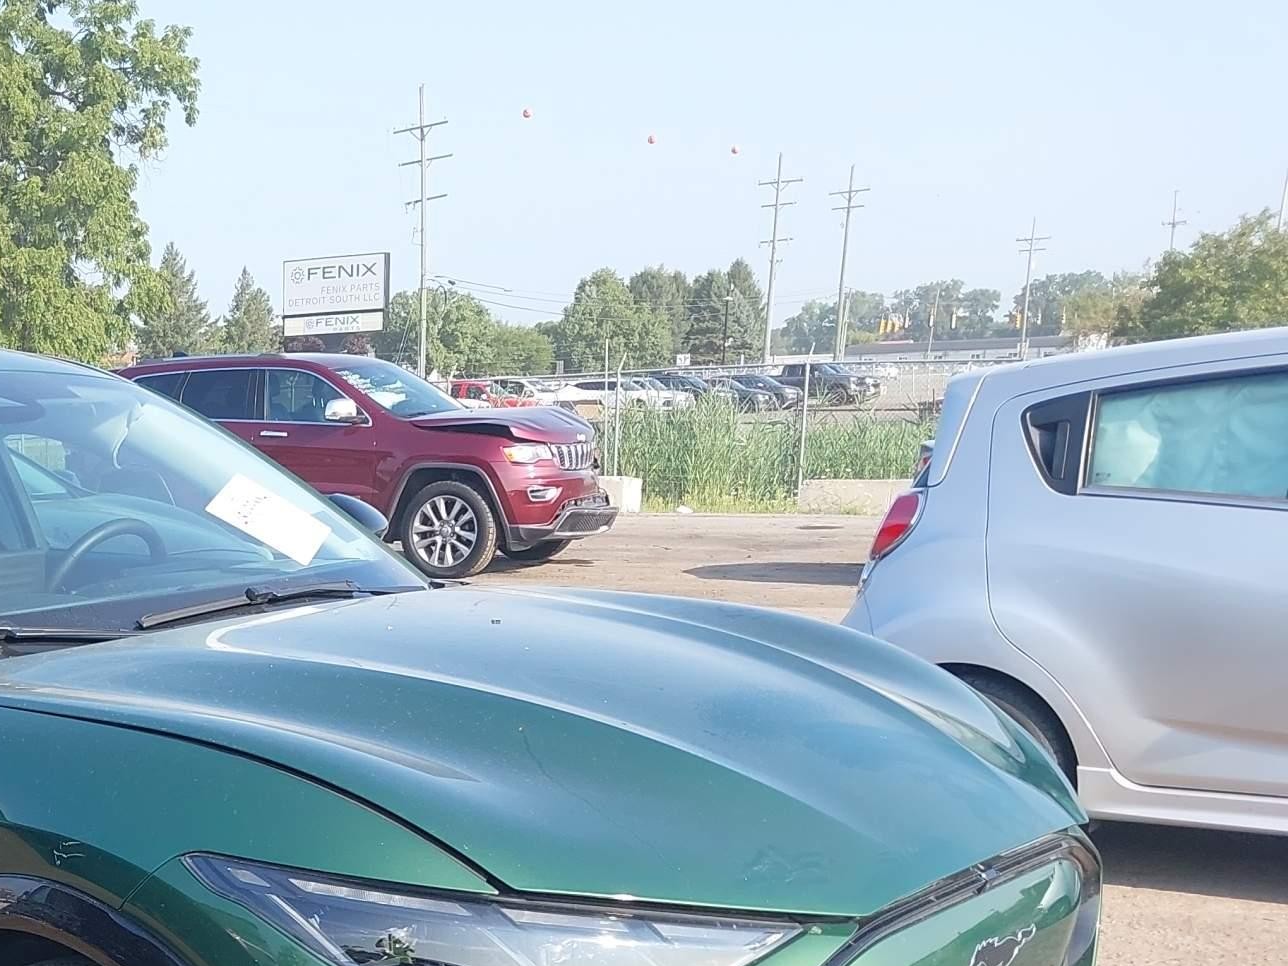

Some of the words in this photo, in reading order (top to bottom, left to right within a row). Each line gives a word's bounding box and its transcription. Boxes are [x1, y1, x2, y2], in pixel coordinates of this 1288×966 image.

[307, 262, 377, 280] FENIX
[320, 285, 348, 295] FENIX
[350, 282, 380, 292] PARTS
[288, 296, 328, 307] DETROIT
[329, 294, 361, 304] SOUTH
[363, 292, 380, 302] LLC
[315, 315, 360, 327] FENIX
